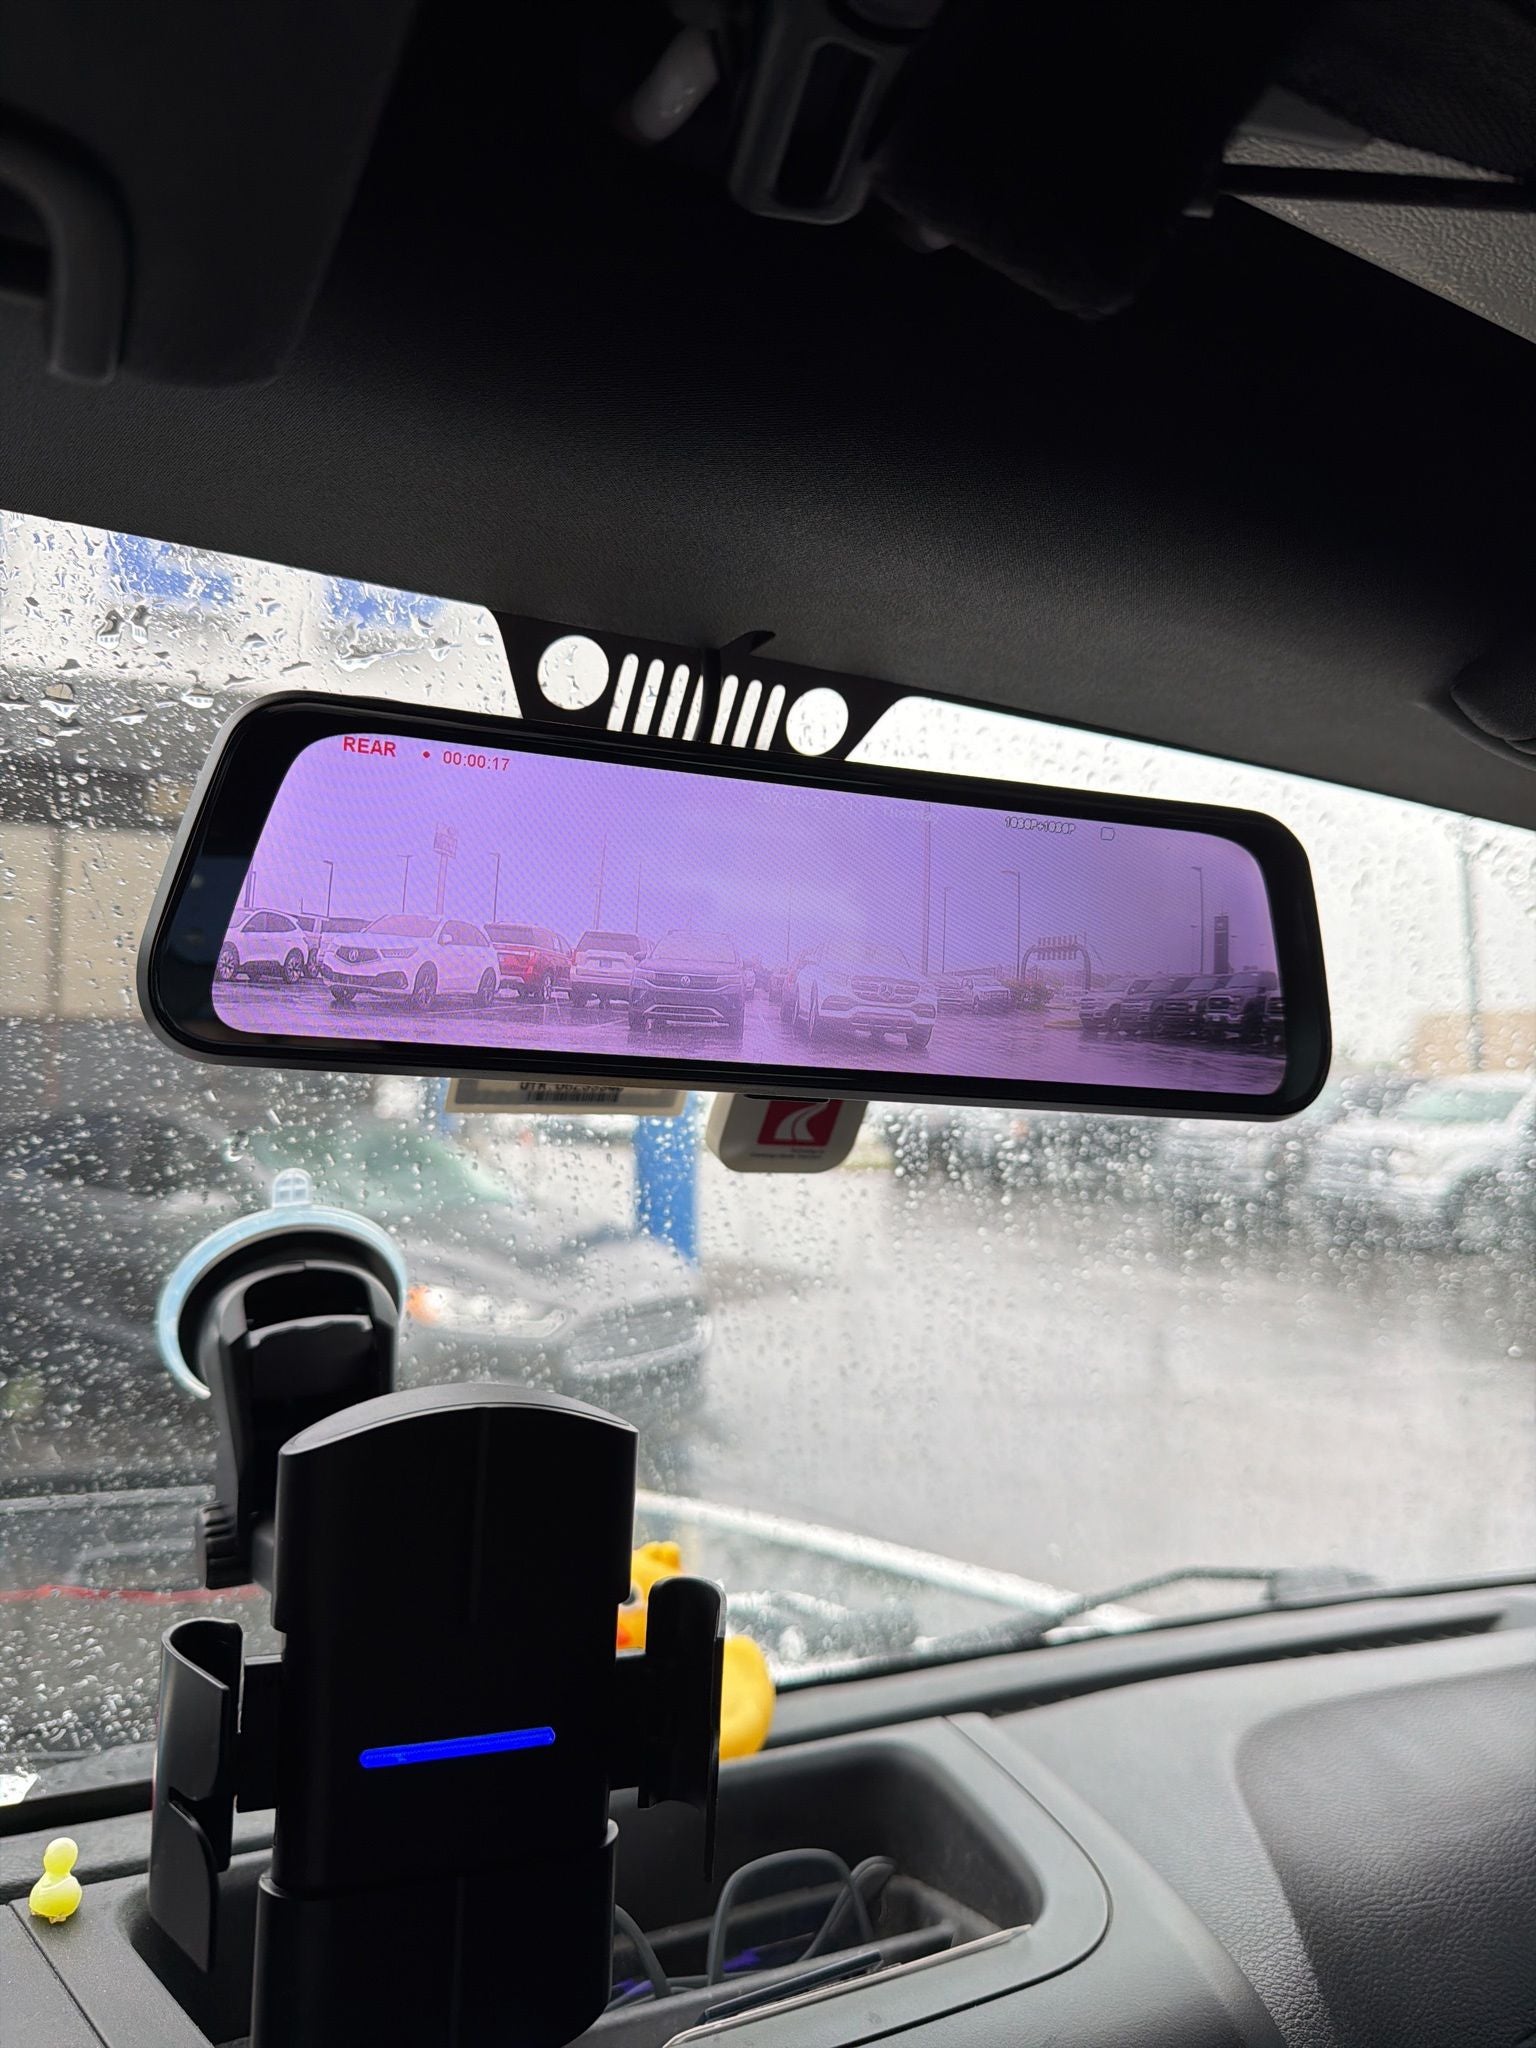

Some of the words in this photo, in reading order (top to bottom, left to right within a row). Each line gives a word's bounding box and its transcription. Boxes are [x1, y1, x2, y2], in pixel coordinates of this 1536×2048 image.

[343, 736, 396, 757] REAR
[443, 751, 510, 771] 00:00:17
[1005, 815, 1077, 836] 1080P+1080P
